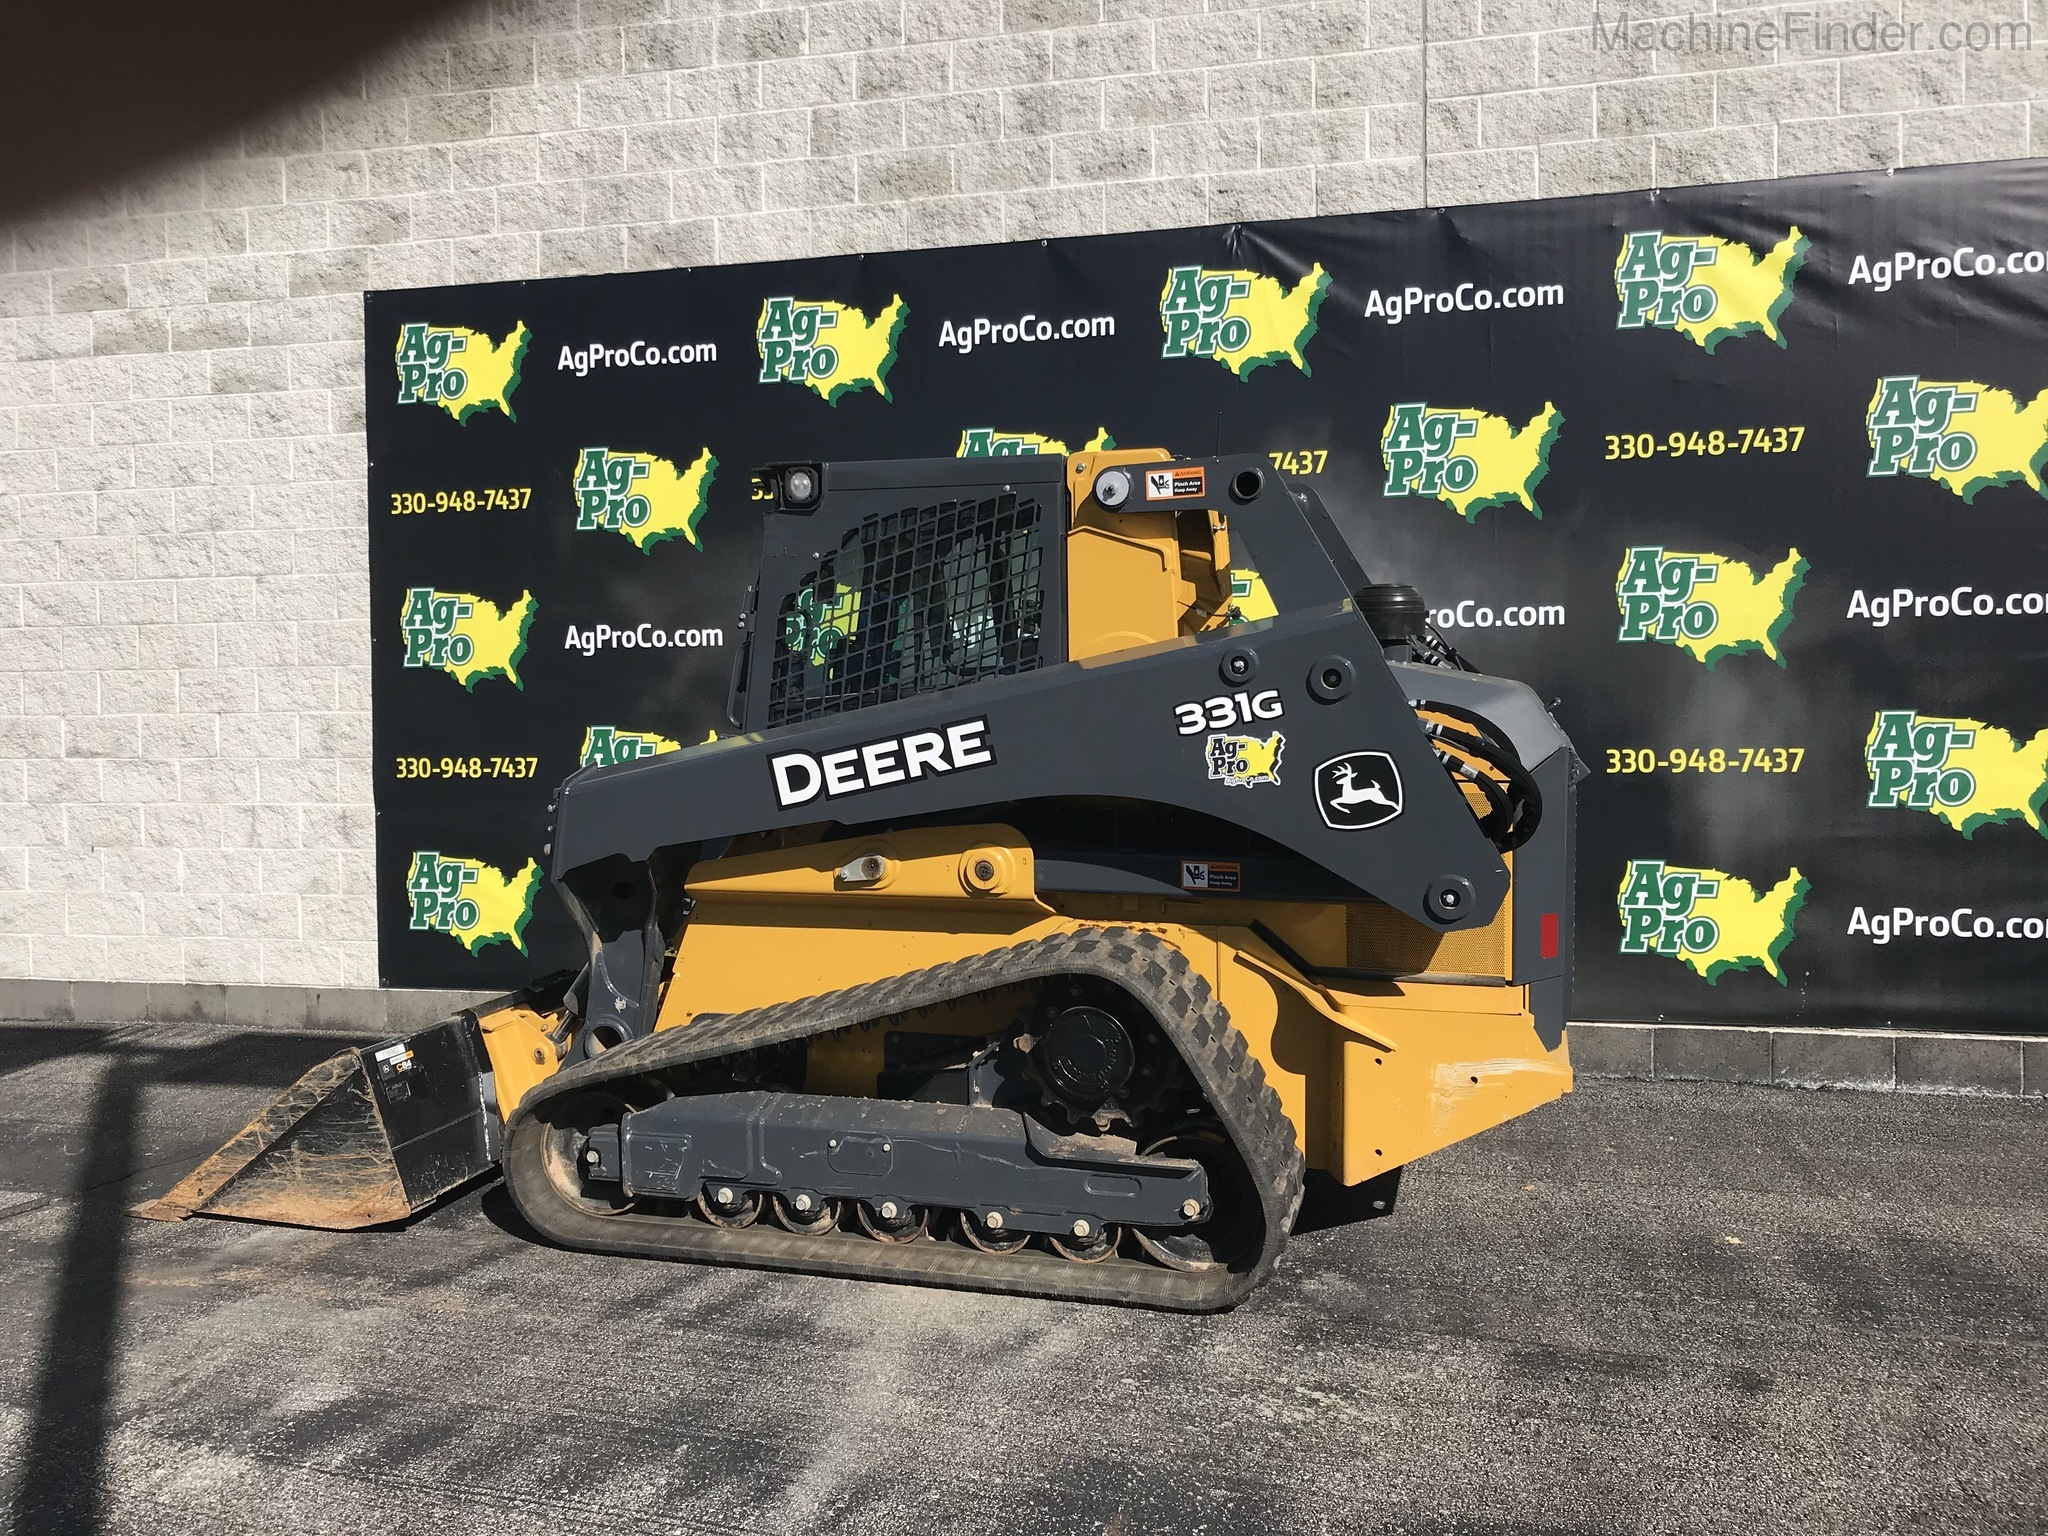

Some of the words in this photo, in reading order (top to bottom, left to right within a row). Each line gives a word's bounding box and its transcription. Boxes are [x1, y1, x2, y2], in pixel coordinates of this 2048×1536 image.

[1618, 229, 1716, 286] Ag-
[1848, 247, 2048, 291] AgProCo.co
[1163, 265, 1250, 317] Ag-
[1365, 283, 1564, 324] AgProCo.com
[1617, 281, 1718, 330] Pro
[759, 297, 837, 341] Ag-
[938, 315, 1116, 354] AgProCo.com
[1161, 310, 1250, 359] Pro
[399, 323, 465, 364] Ag-
[558, 341, 717, 377] AgProCo.com
[758, 339, 839, 384] Pro
[398, 362, 467, 403] Pro
[1868, 375, 1977, 435] Ag-
[1385, 402, 1478, 455] Ag-
[1605, 427, 1805, 460] 330-948-7437
[577, 448, 649, 489] Ag-
[1268, 450, 1328, 475] 7437
[1383, 448, 1479, 498] Pro
[1867, 425, 1977, 478] Pro
[391, 489, 531, 515] 330-948-7437
[576, 486, 650, 530] Pro
[1619, 546, 1718, 597] Ag-
[404, 588, 472, 630] Ag-
[1618, 594, 1719, 643] Pro
[1846, 586, 2048, 627] AgProCo.co
[403, 627, 473, 667] Pro
[564, 624, 724, 656] AgProCo.com
[1174, 689, 1284, 735] 331G
[1209, 737, 1248, 761] Ag-
[1868, 709, 1976, 763] Ag-
[396, 757, 538, 779] 330-948-7437
[771, 719, 993, 806] DEERE
[1209, 756, 1250, 777] Pro
[1606, 748, 1805, 774] 330-948-7437
[1867, 758, 1977, 809] Pro
[409, 851, 478, 893] Ag-
[1620, 859, 1719, 911] Ag-
[409, 890, 479, 930] Pro
[1619, 906, 1720, 954] Pro
[1846, 907, 2048, 944] AgProCo.co
